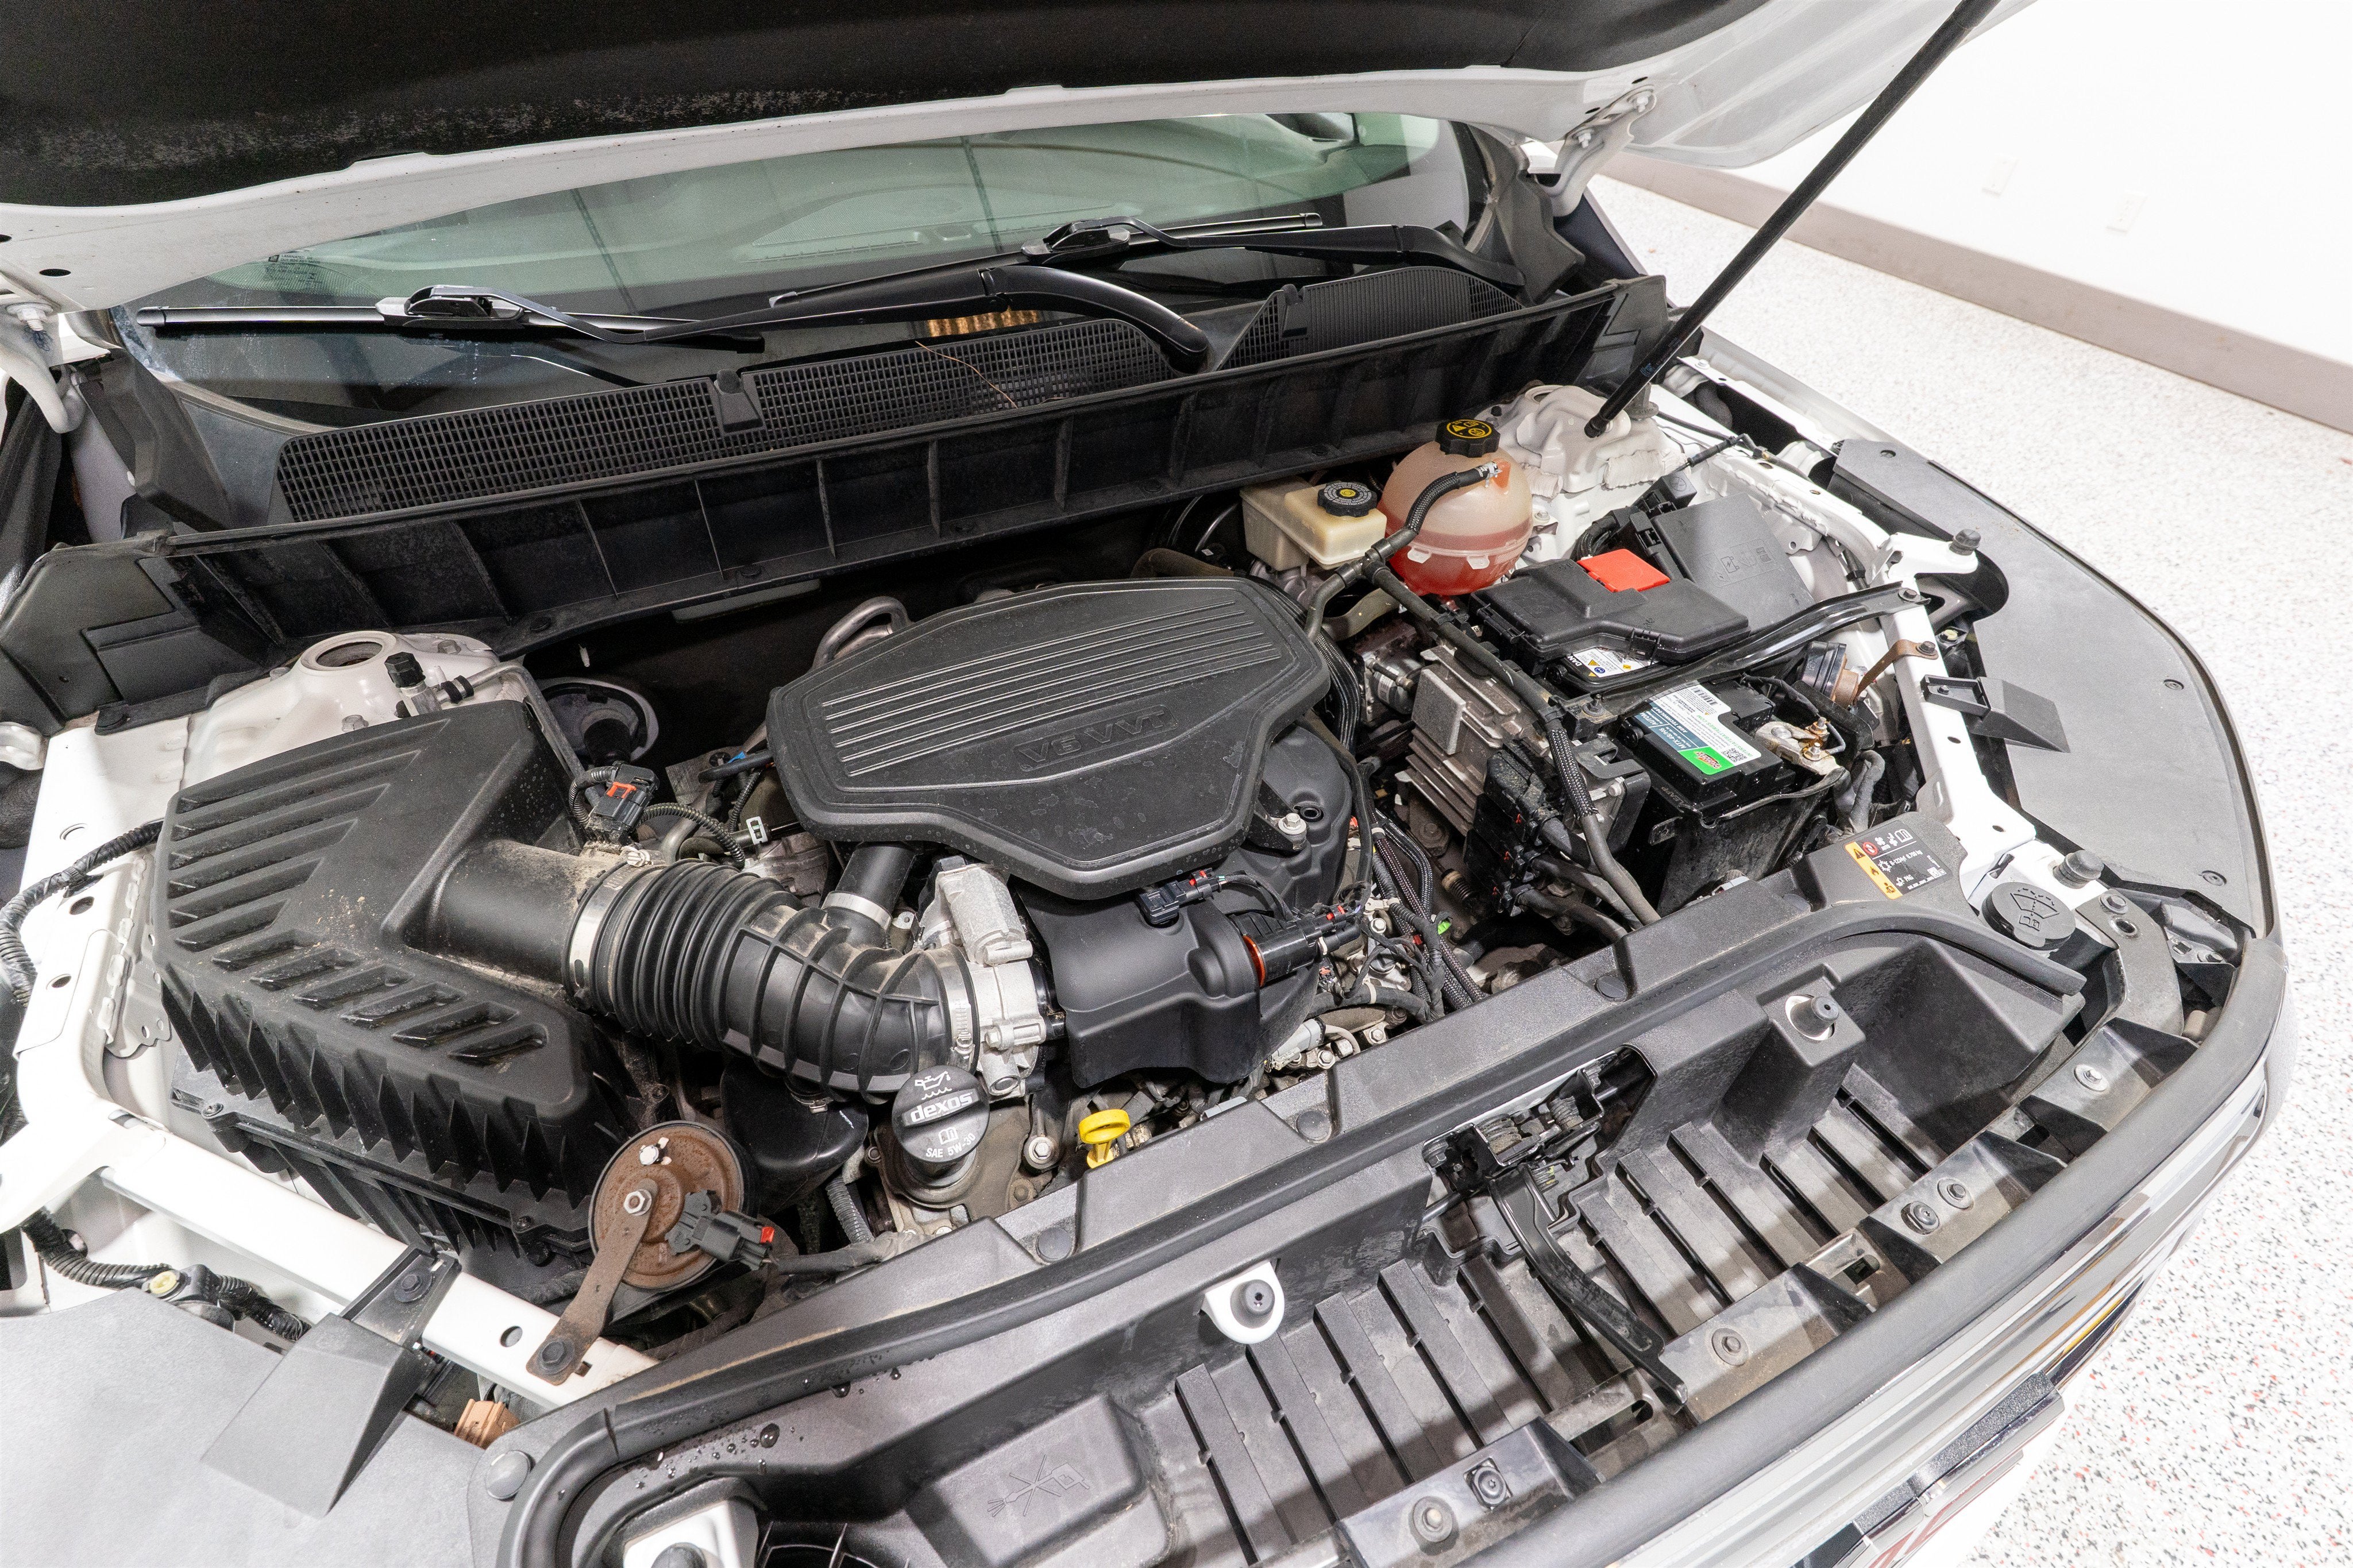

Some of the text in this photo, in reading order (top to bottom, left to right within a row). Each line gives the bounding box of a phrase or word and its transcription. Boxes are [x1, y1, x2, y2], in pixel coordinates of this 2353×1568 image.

[1652, 706, 1688, 733] AGM TECHNOLOGY
[1019, 710, 1164, 762] V6 VVT
[1657, 727, 1687, 749] MTX-48/H6
[911, 1093, 973, 1123] dexos
[926, 1133, 976, 1158] SAE 5W-30
